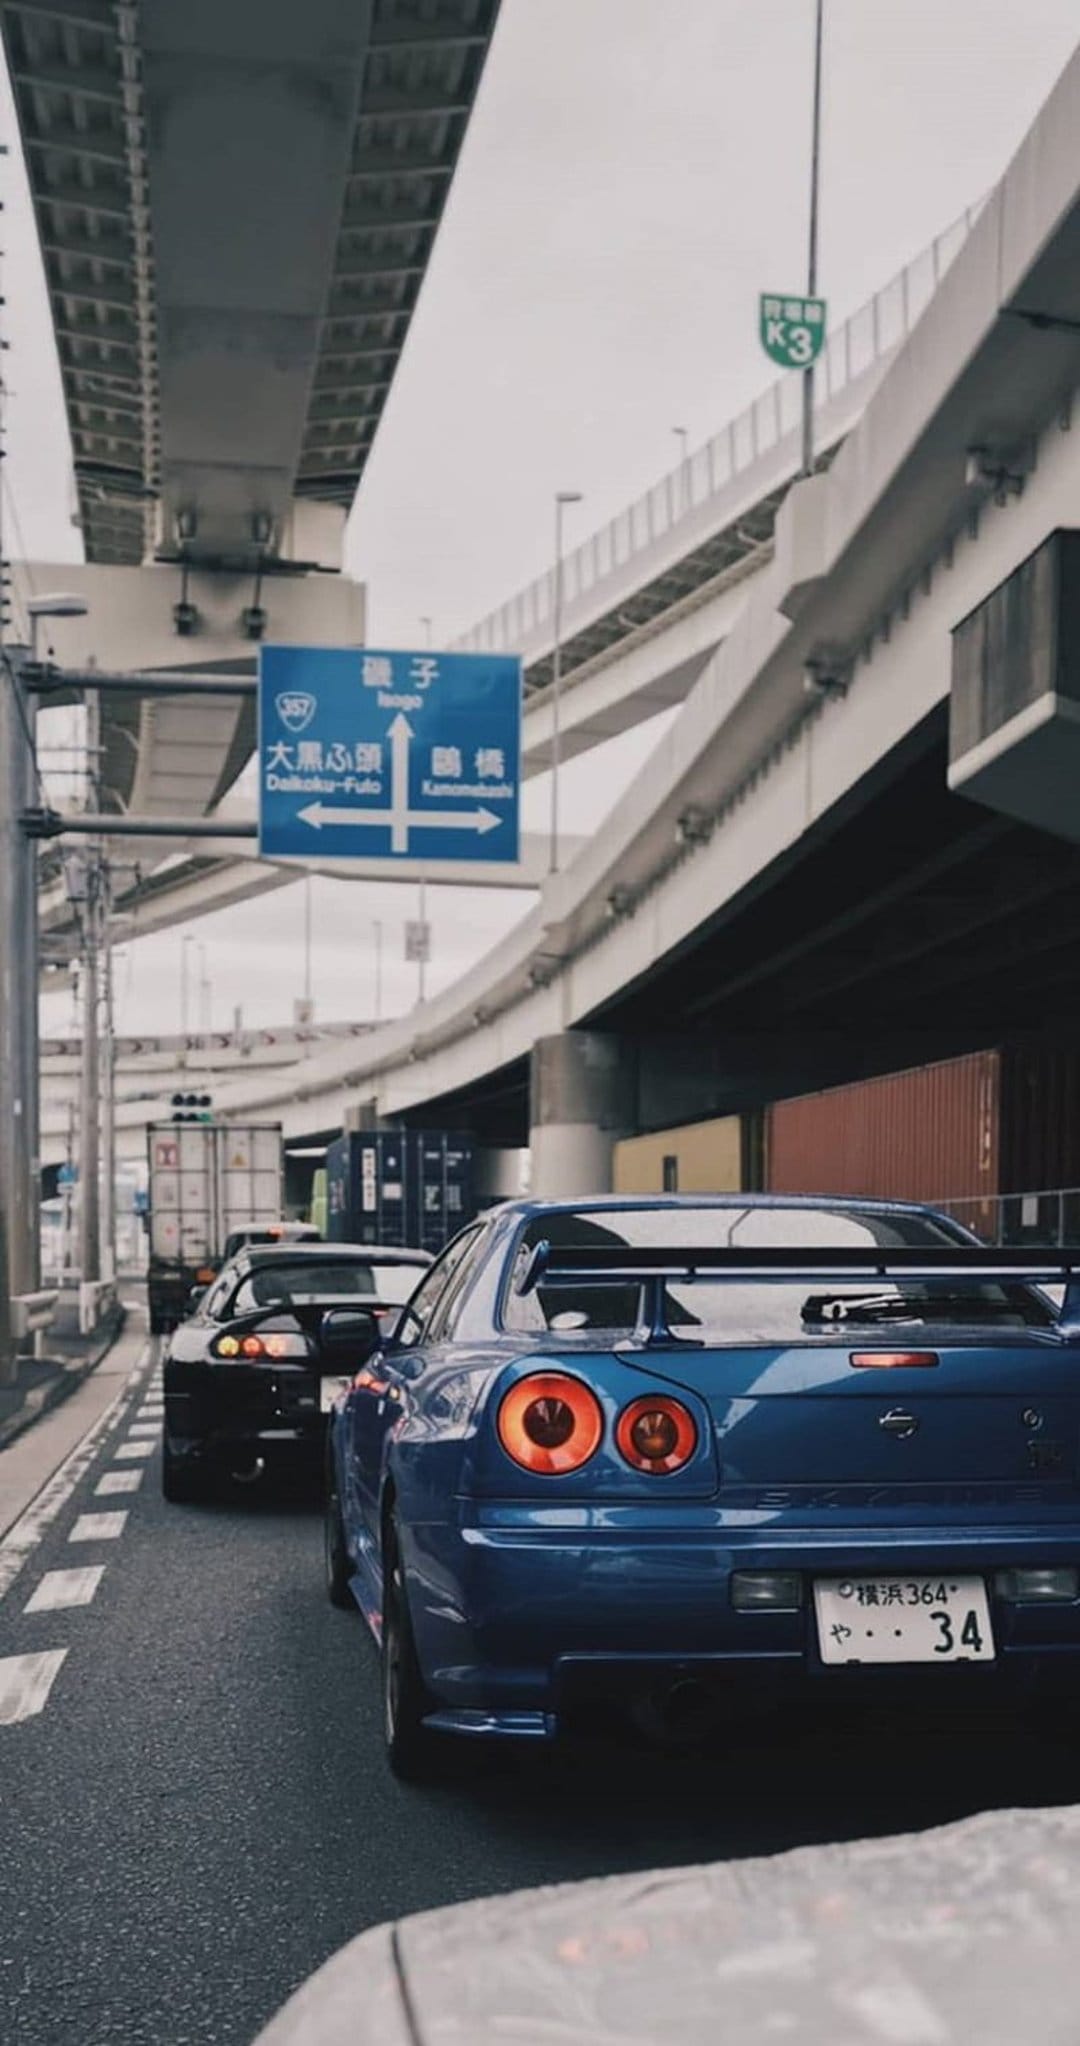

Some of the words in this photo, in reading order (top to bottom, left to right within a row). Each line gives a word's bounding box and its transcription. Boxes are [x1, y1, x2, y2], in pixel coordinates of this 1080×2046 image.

[767, 321, 813, 363] K3
[361, 655, 441, 690] 磯子
[280, 697, 310, 717] 357
[377, 690, 424, 711] Isogo
[265, 740, 384, 774] 大黒ふ頭
[266, 773, 382, 794] Daikoku-Futo
[756, 1489, 1043, 1508] SKYE
[929, 1609, 984, 1653] 34
